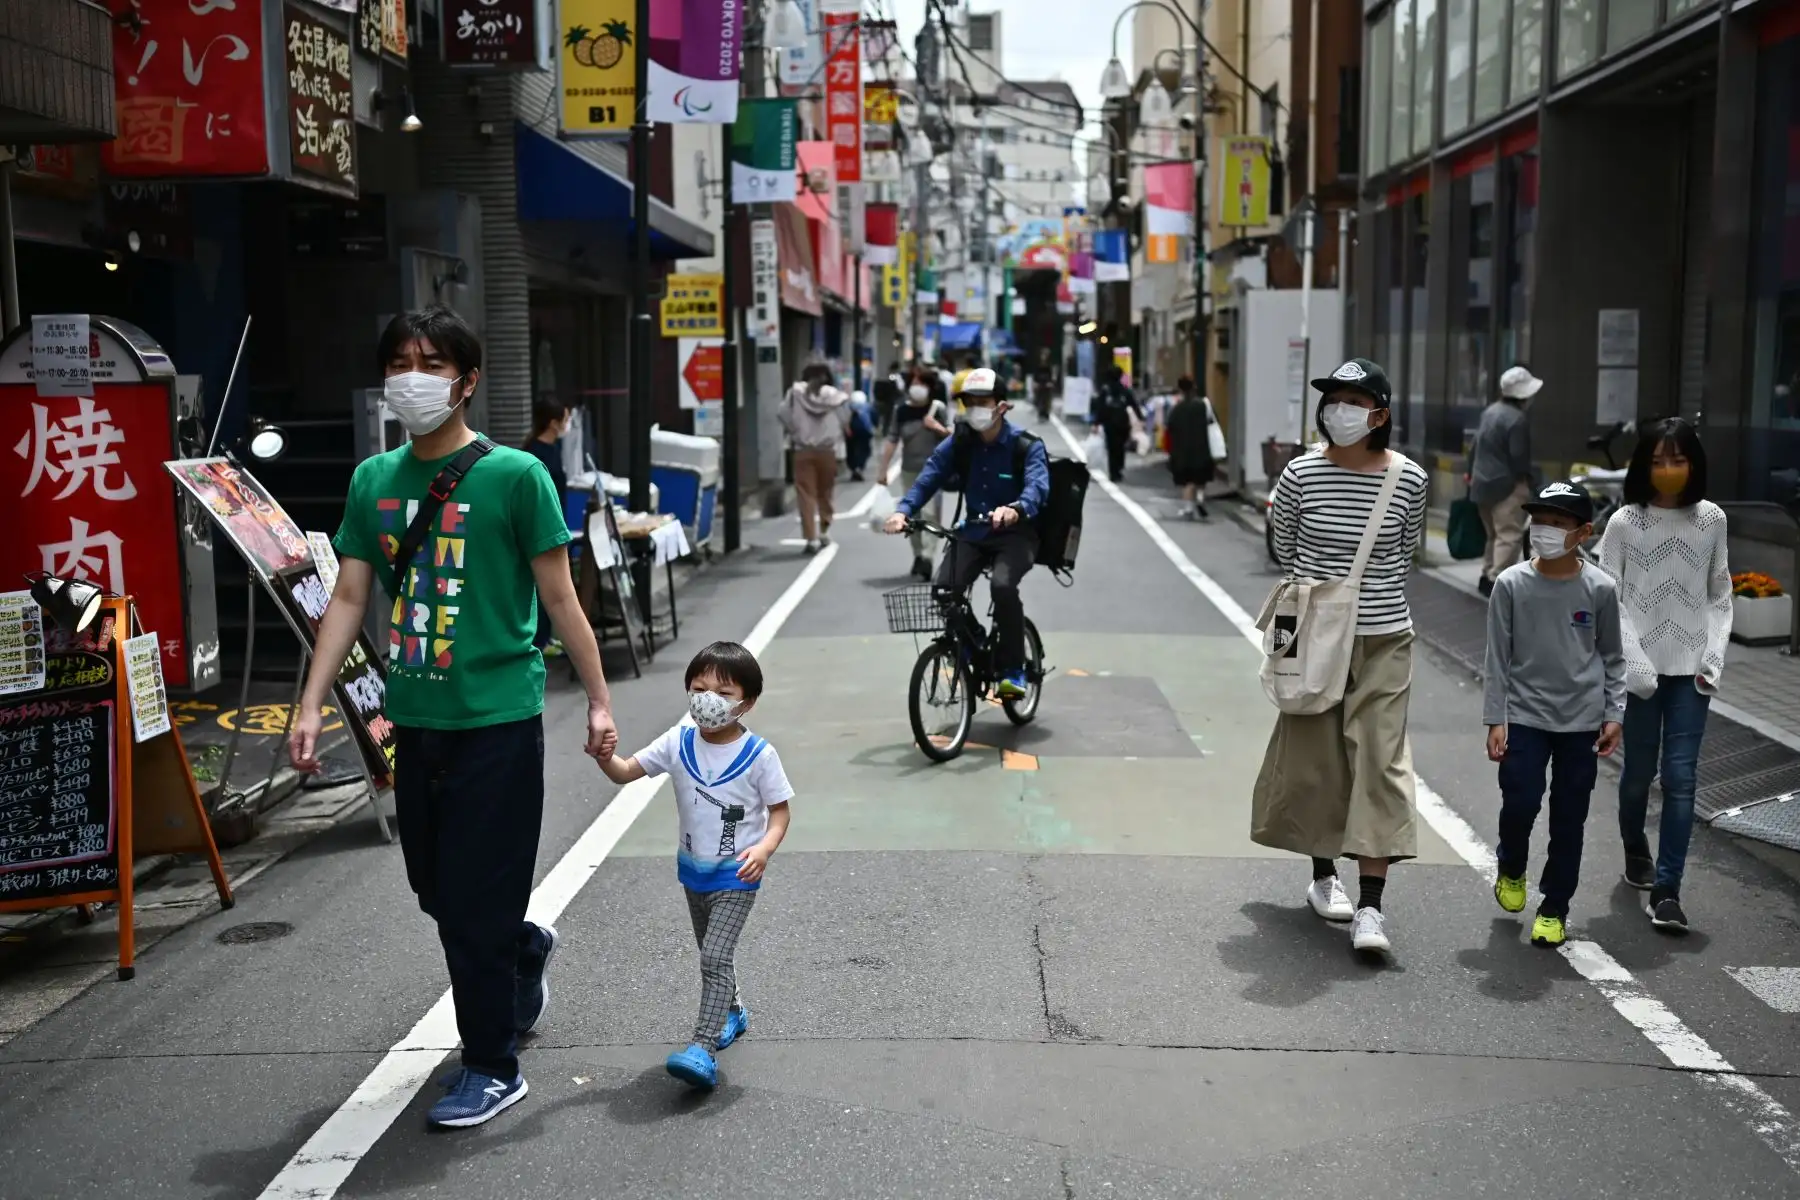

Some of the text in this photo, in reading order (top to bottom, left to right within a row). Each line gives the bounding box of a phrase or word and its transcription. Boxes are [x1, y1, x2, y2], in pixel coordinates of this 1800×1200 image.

[456, 9, 522, 39] あかり
[719, 0, 735, 76] OKYO 2020
[589, 106, 615, 123] B1
[781, 108, 792, 141] TOKYO
[1546, 481, 1573, 493] NIKE
[13, 397, 138, 600] 焼肉
[52, 745, 91, 761] ¥630
[53, 758, 90, 775] ¥680
[53, 773, 90, 793] ¥499
[49, 807, 88, 827] ¥499
